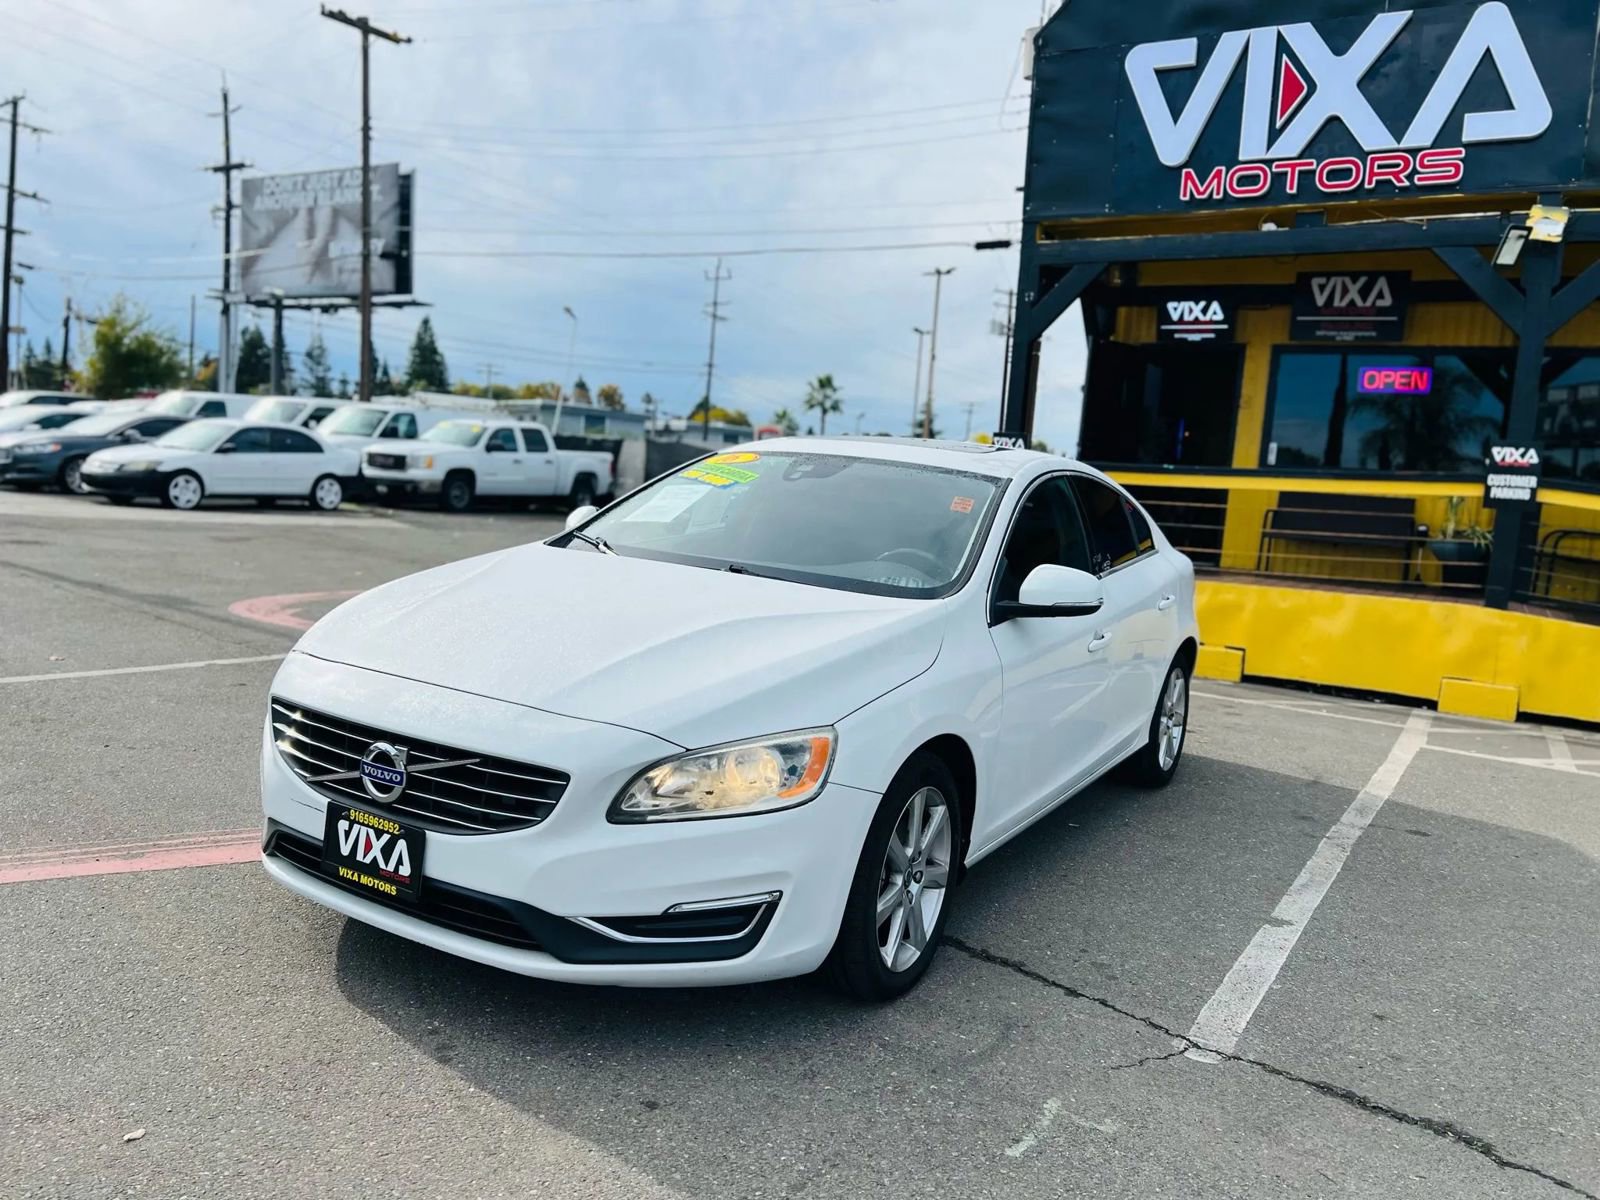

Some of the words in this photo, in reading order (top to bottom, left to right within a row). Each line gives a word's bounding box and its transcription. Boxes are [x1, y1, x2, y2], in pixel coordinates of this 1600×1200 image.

[1125, 1, 1553, 168] VIXA
[1179, 147, 1467, 202] MOTORS
[1311, 275, 1393, 307] VIXA
[1166, 300, 1225, 322] VIXA
[1363, 370, 1429, 390] OPEN
[1491, 446, 1540, 465] VIXA
[1487, 473, 1538, 489] CUSTOMER
[1489, 486, 1532, 501] PARKING
[363, 764, 401, 782] VOLVO
[349, 809, 400, 835] 9165962952
[337, 819, 412, 877] VIXA
[338, 867, 359, 882] VIXA
[360, 874, 397, 896] MOTORS
